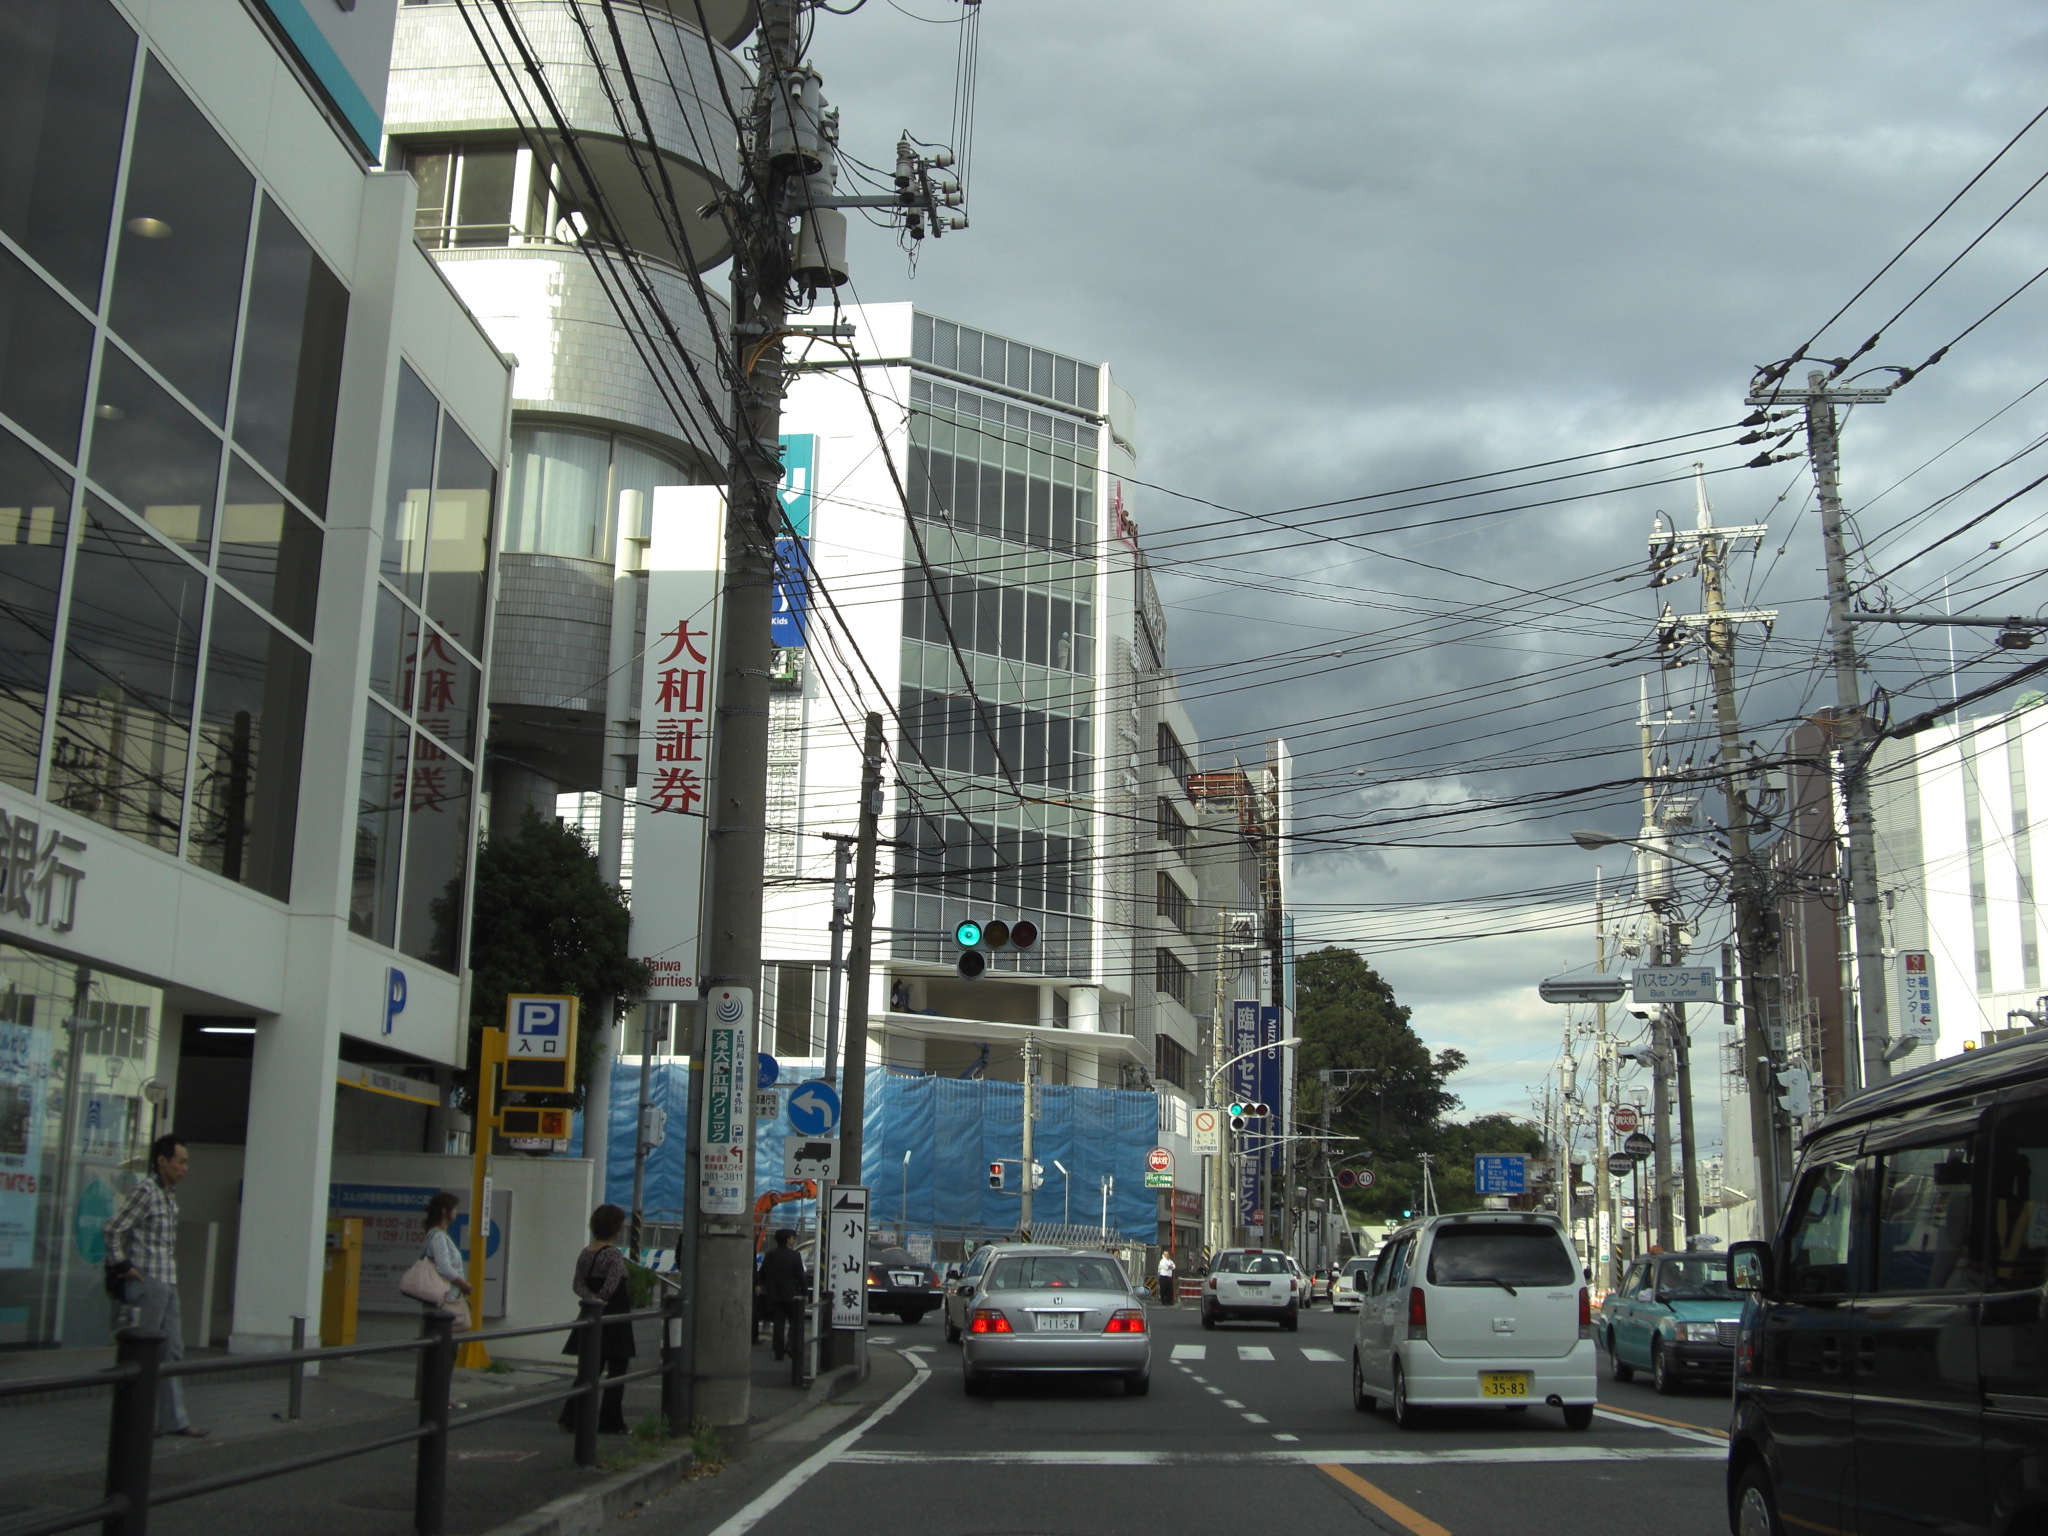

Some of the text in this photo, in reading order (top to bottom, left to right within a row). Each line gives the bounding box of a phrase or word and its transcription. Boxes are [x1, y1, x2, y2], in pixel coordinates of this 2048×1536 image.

[771, 617, 788, 625] Kids
[650, 619, 708, 815] 大和証券
[1636, 971, 1711, 987] バスセンター前
[1650, 987, 1697, 997] Bus Center
[1918, 976, 1931, 1015] 補聴器
[382, 966, 407, 1034] P
[1905, 977, 1918, 1024] センター
[523, 1005, 556, 1034] P
[518, 1039, 556, 1054] 入口
[1236, 1006, 1257, 1152] 臨海セミー
[1615, 1115, 1636, 1126] 消火栓
[733, 1126, 743, 1136] P
[704, 1172, 743, 1181] 881-3811
[1360, 1174, 1371, 1183] 40
[841, 1219, 863, 1310] 小山家
[1049, 1319, 1075, 1329] 11-56
[1492, 1382, 1525, 1395] 35-83
